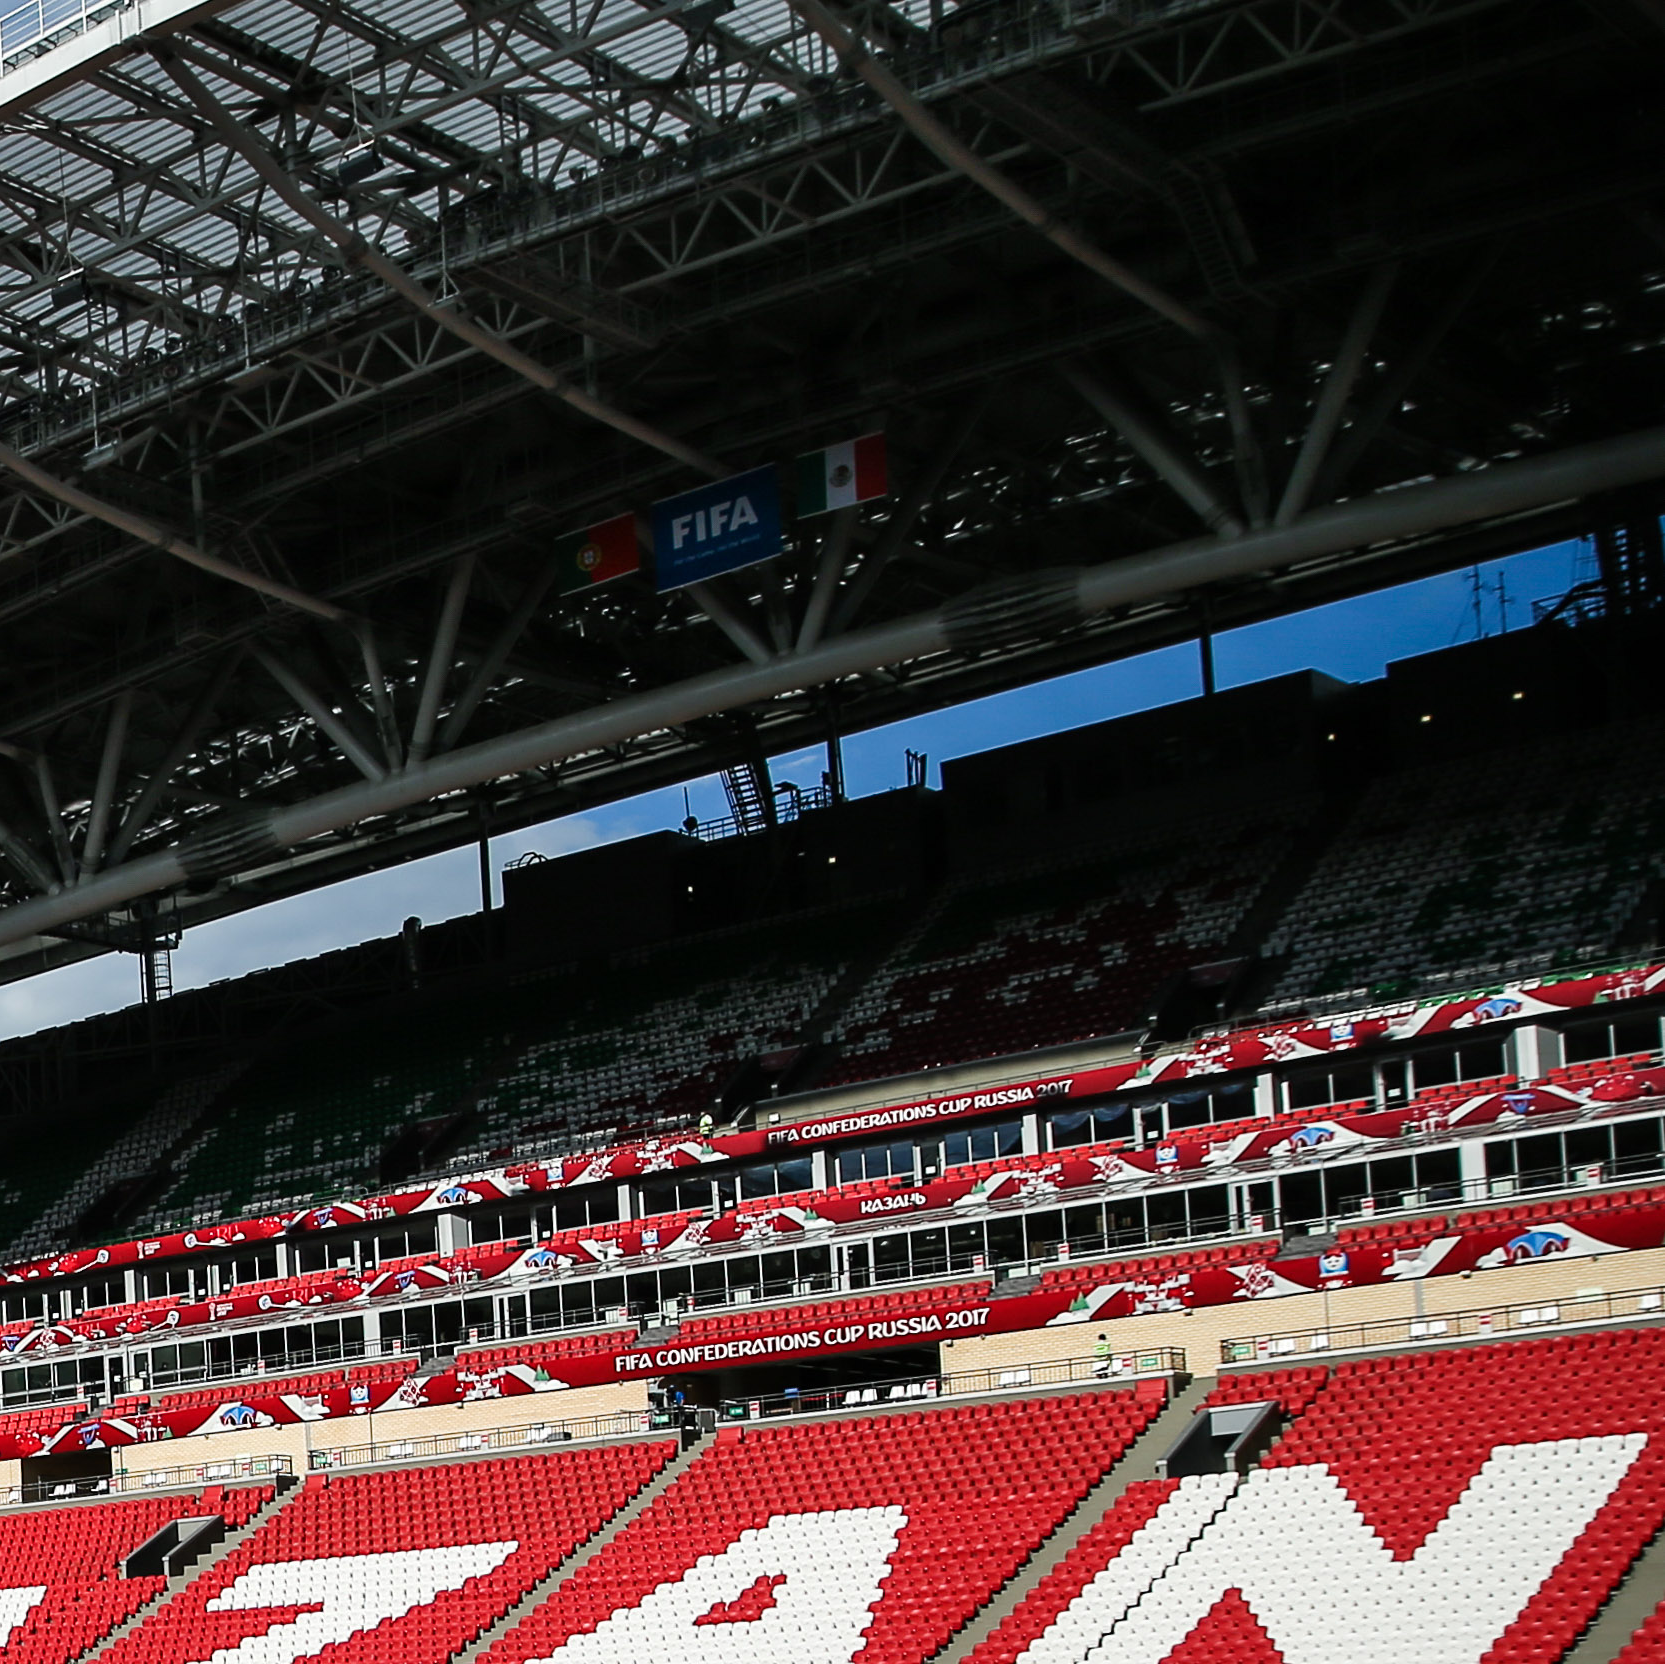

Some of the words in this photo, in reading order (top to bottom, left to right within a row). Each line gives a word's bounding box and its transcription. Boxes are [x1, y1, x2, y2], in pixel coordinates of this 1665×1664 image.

[672, 496, 759, 550] FIFA
[768, 1128, 799, 1144] FIFA
[801, 1104, 936, 1139] CONFEDERATIONS
[939, 1097, 971, 1114] CUP
[974, 1086, 1034, 1108] RUSSIA
[1036, 1080, 1073, 1098] 2017
[861, 1193, 926, 1213] КАЗАНЬ
[615, 1354, 653, 1371] FIFA
[656, 1332, 820, 1366] CONFEDERATIONS
[824, 1326, 864, 1345] CUP
[867, 1315, 941, 1339] RUSSIA
[945, 1308, 990, 1328] 2017
